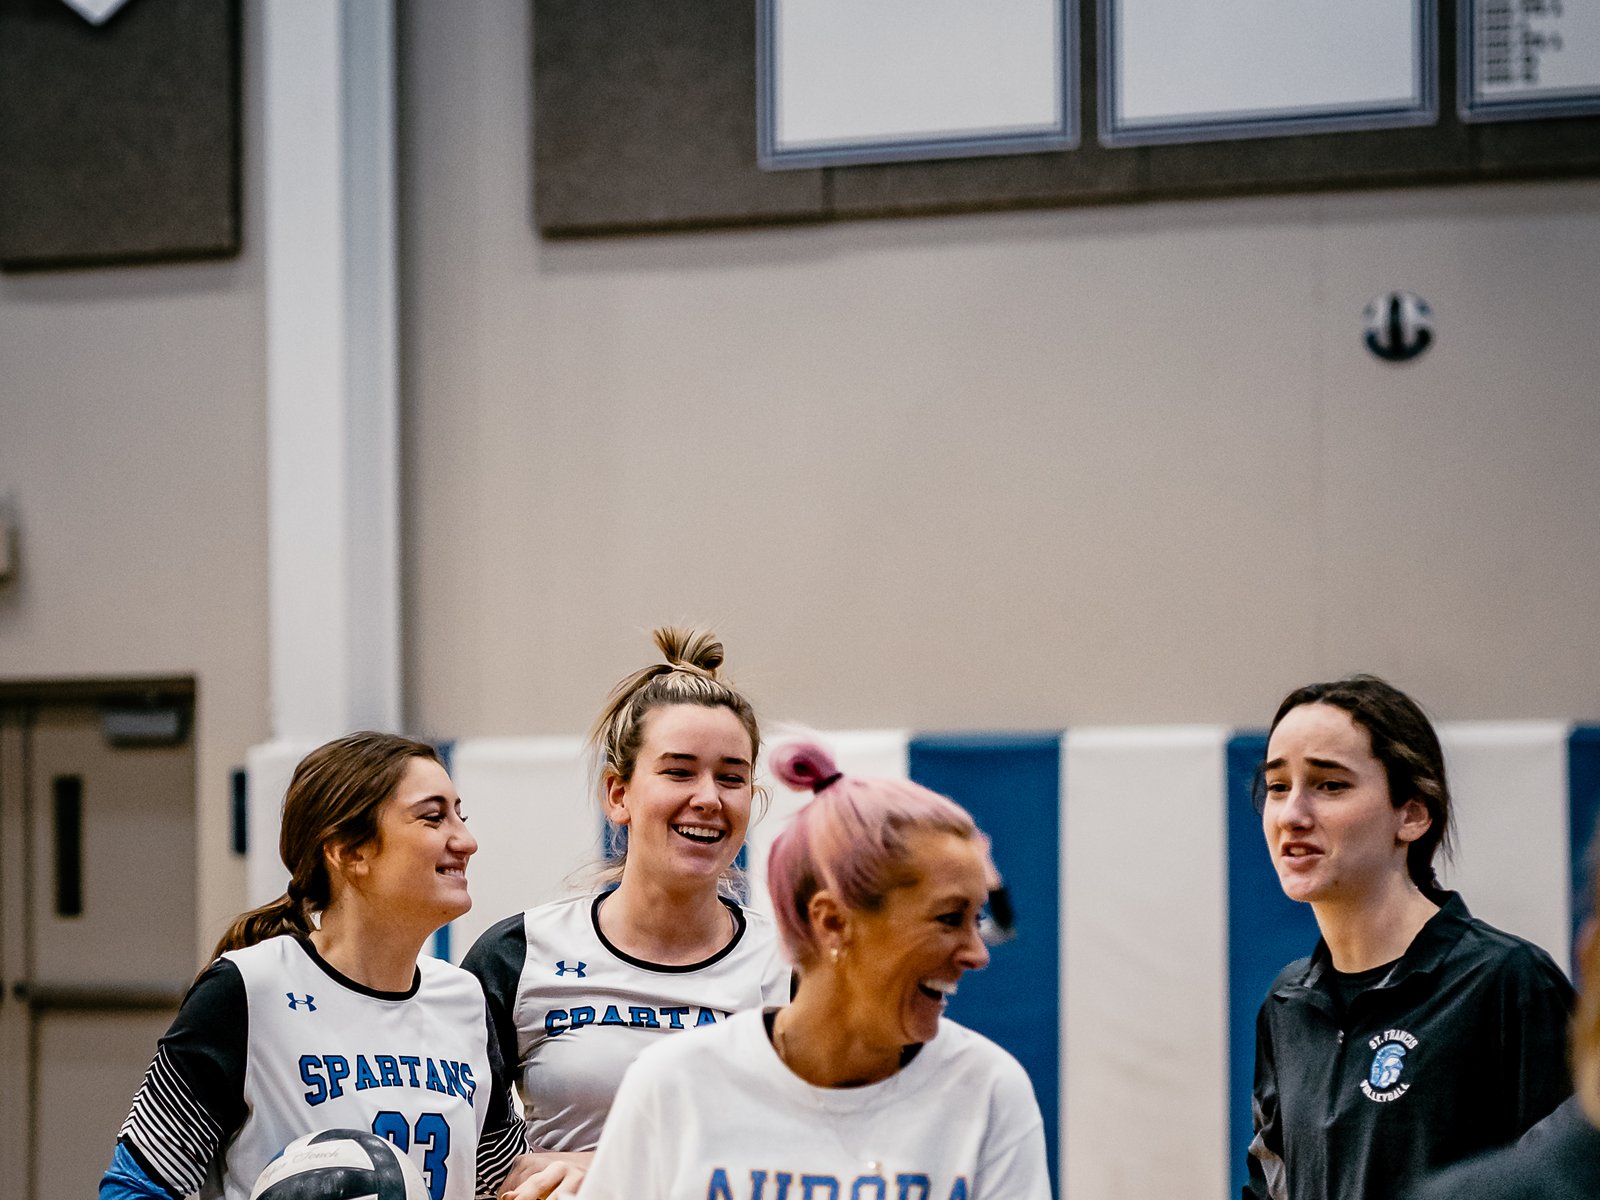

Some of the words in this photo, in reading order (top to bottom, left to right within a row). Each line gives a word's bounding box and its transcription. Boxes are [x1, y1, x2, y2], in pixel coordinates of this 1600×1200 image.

[545, 1004, 734, 1037] SPARTA
[1368, 1035, 1384, 1050] ST.
[1384, 1029, 1419, 1050] FRANCIS
[298, 1054, 477, 1108] SPARTANS
